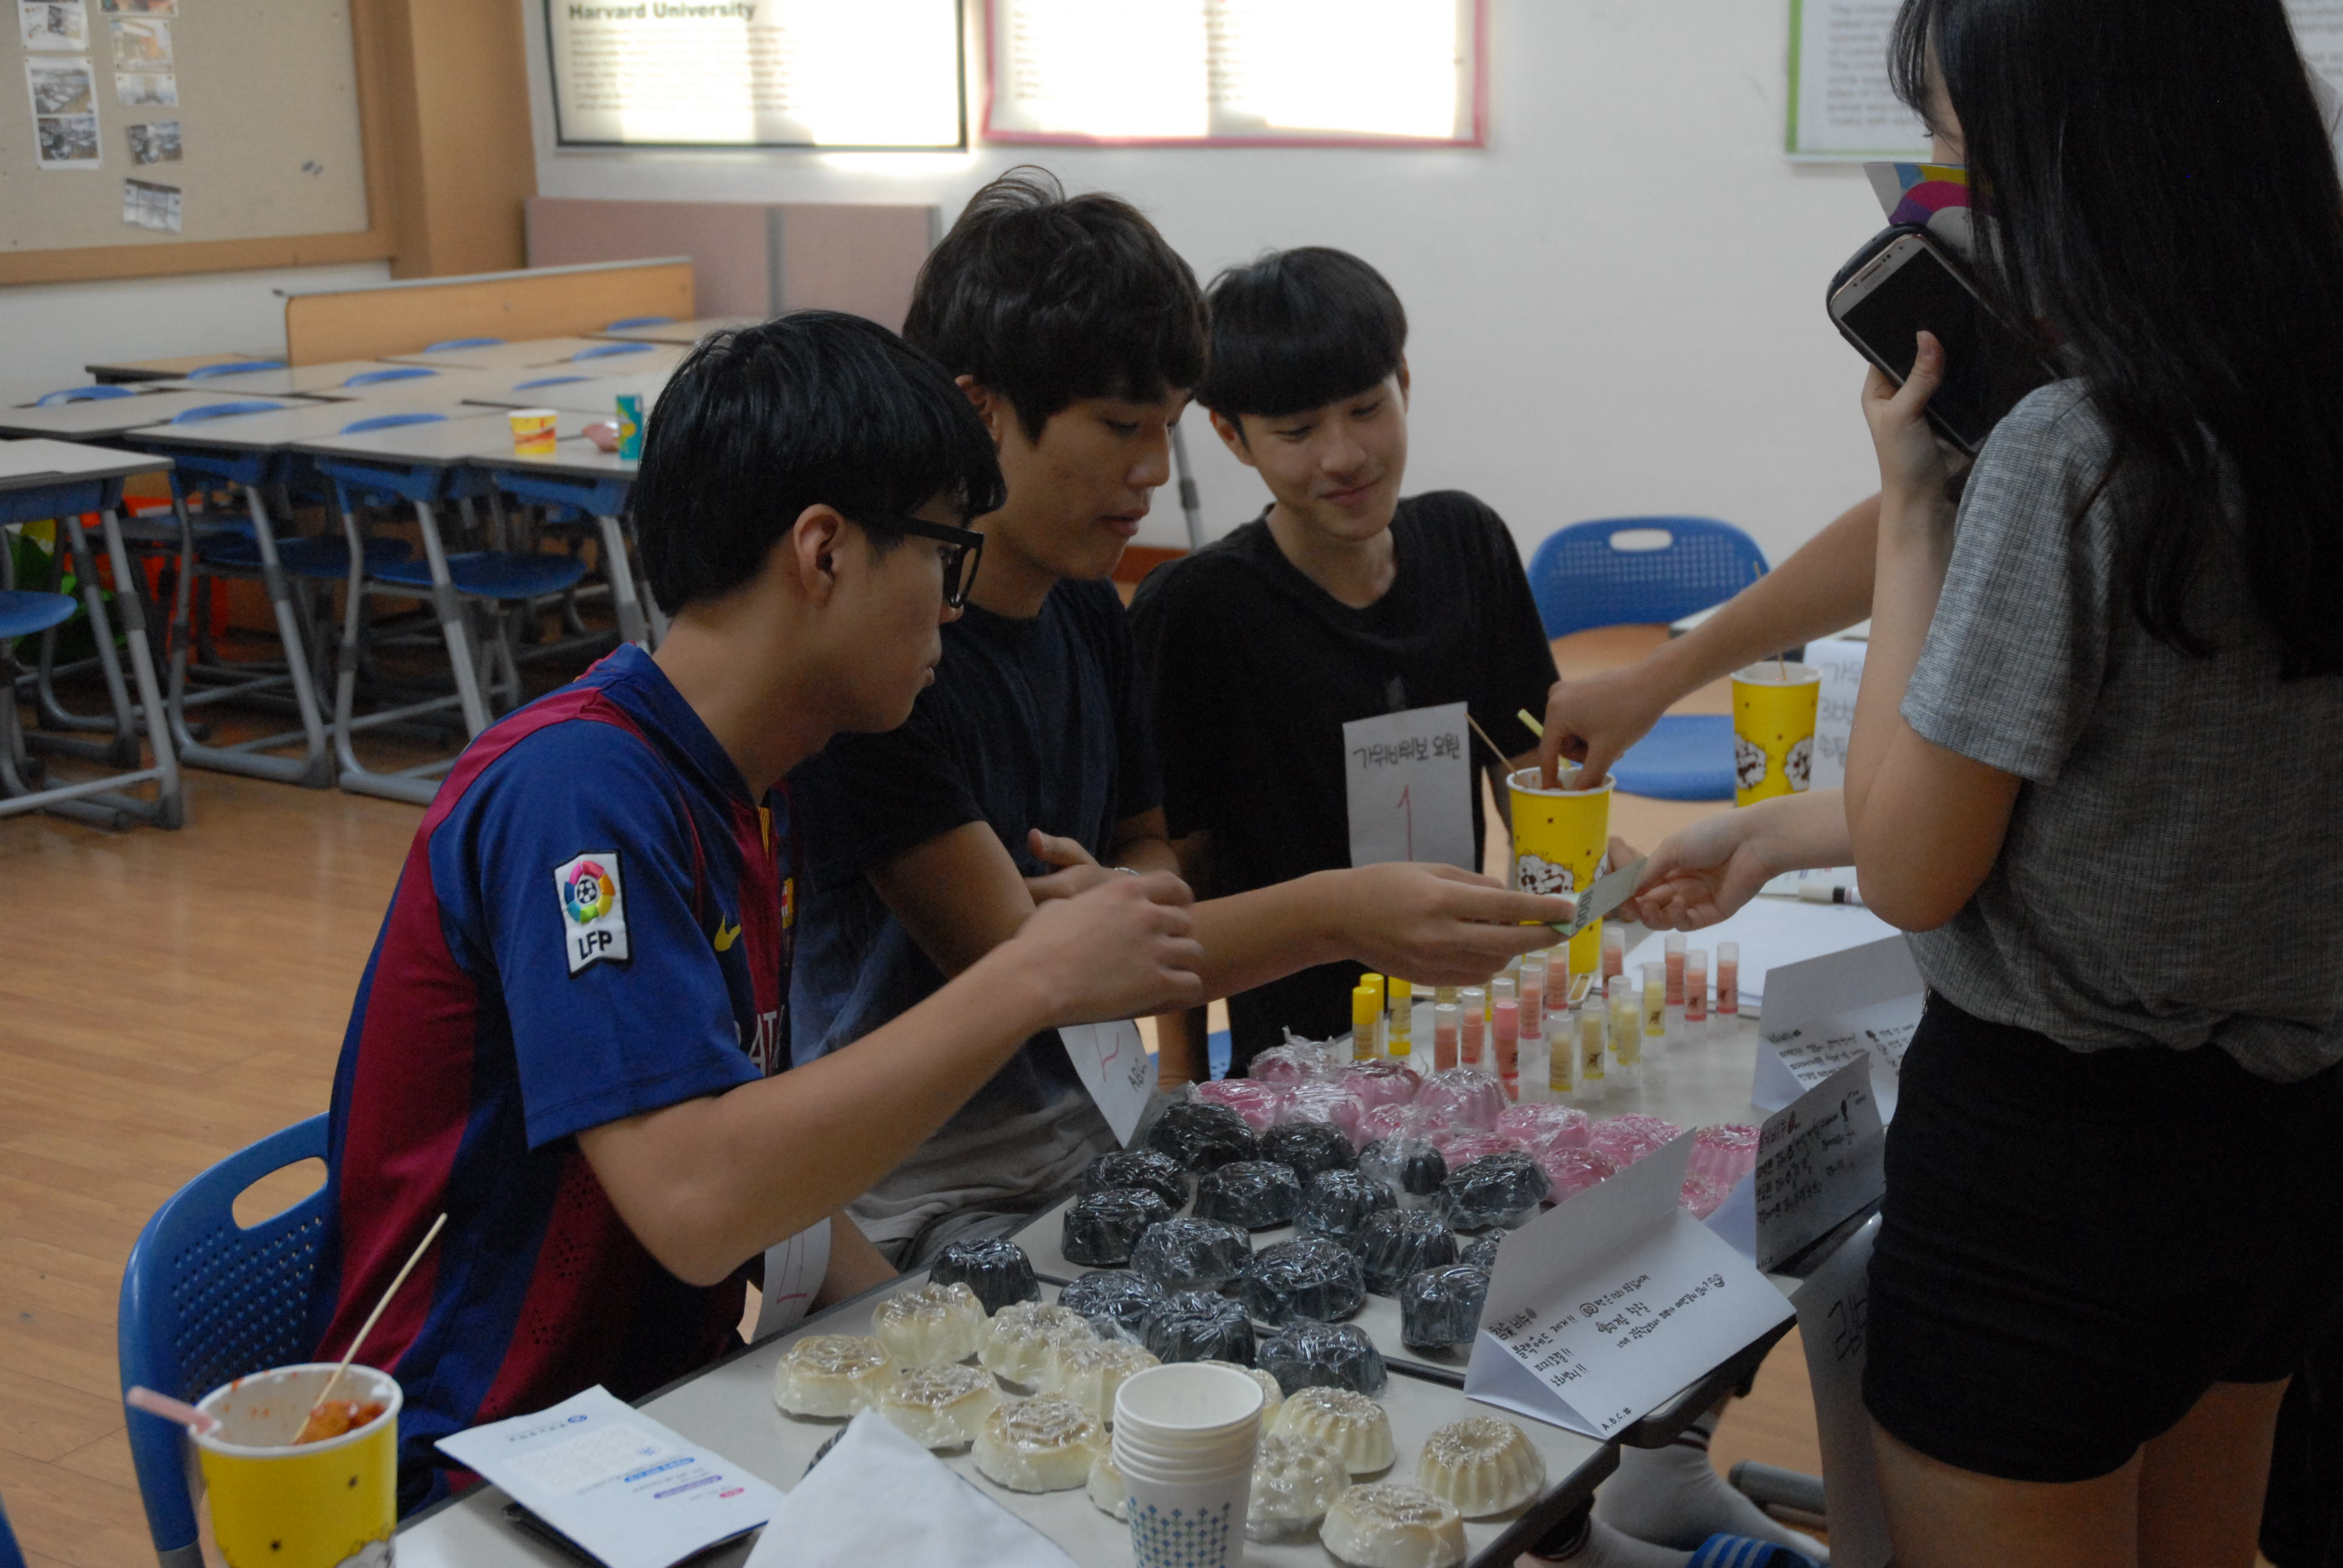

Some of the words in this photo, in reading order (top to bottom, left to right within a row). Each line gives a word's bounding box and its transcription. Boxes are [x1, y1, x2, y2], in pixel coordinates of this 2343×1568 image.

[568, 2, 646, 19] Harvard
[653, 1, 756, 22] University
[1352, 736, 1429, 769] 가위바위보
[1432, 733, 1460, 760] 요원
[1575, 889, 1594, 929] 1000
[578, 930, 612, 960] LFP
[1509, 1313, 1533, 1329] 비누
